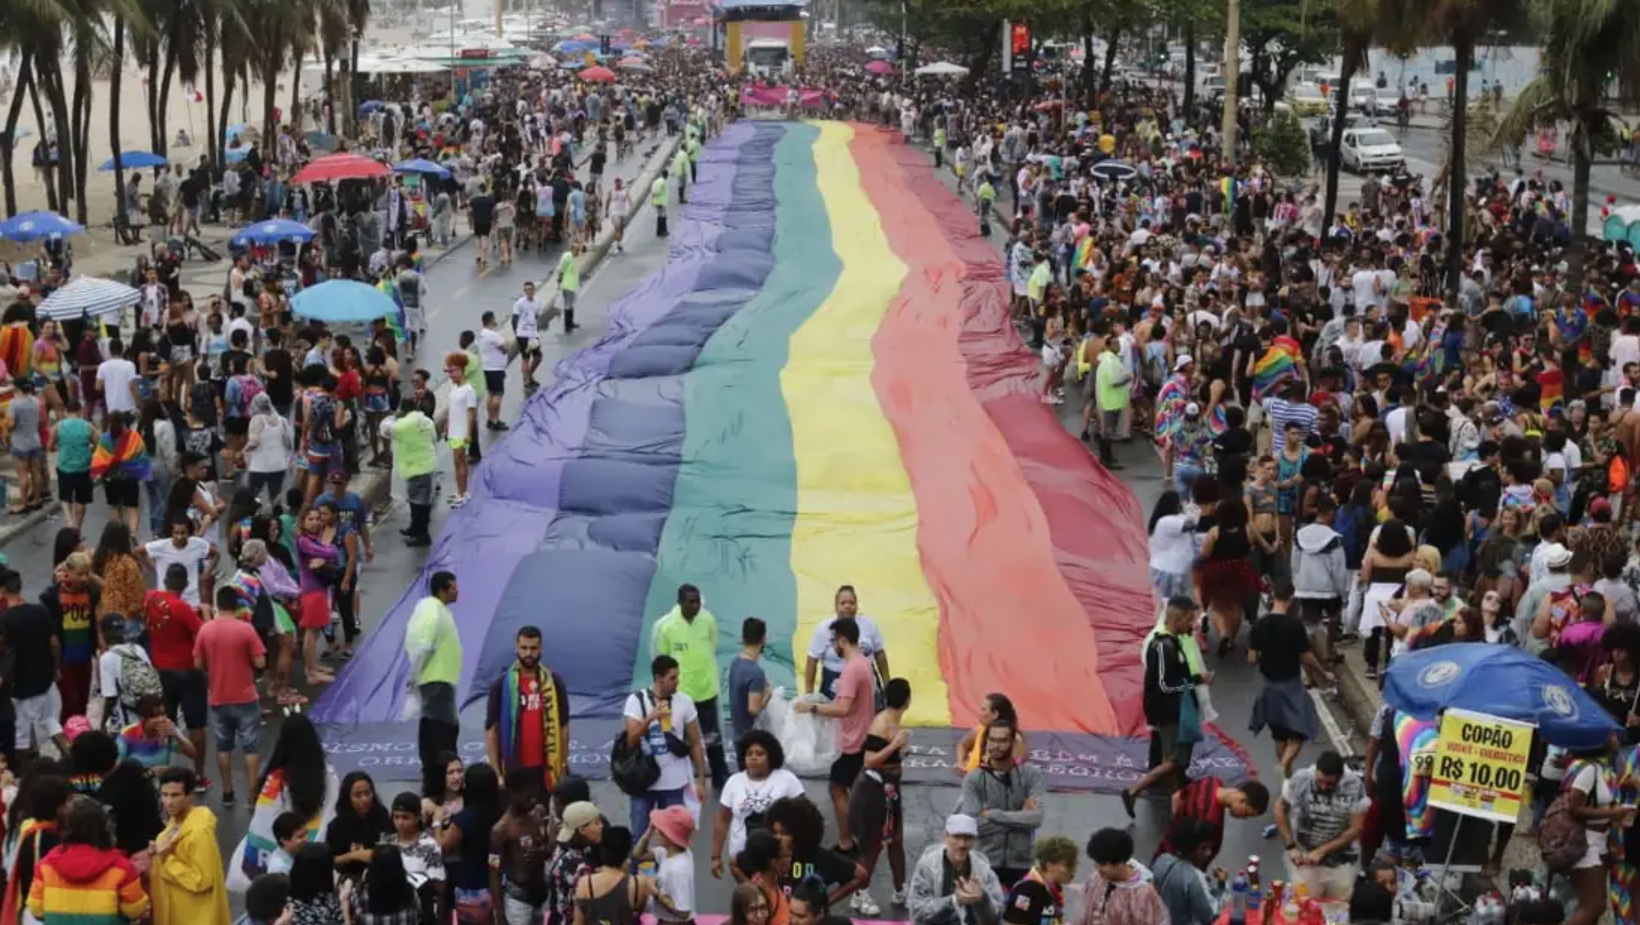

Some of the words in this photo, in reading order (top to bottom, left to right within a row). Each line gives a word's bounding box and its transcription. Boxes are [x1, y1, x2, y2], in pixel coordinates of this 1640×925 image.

[1461, 723, 1513, 749] COPÃO
[1439, 756, 1464, 780] R$
[1469, 761, 1521, 791] 10,00
